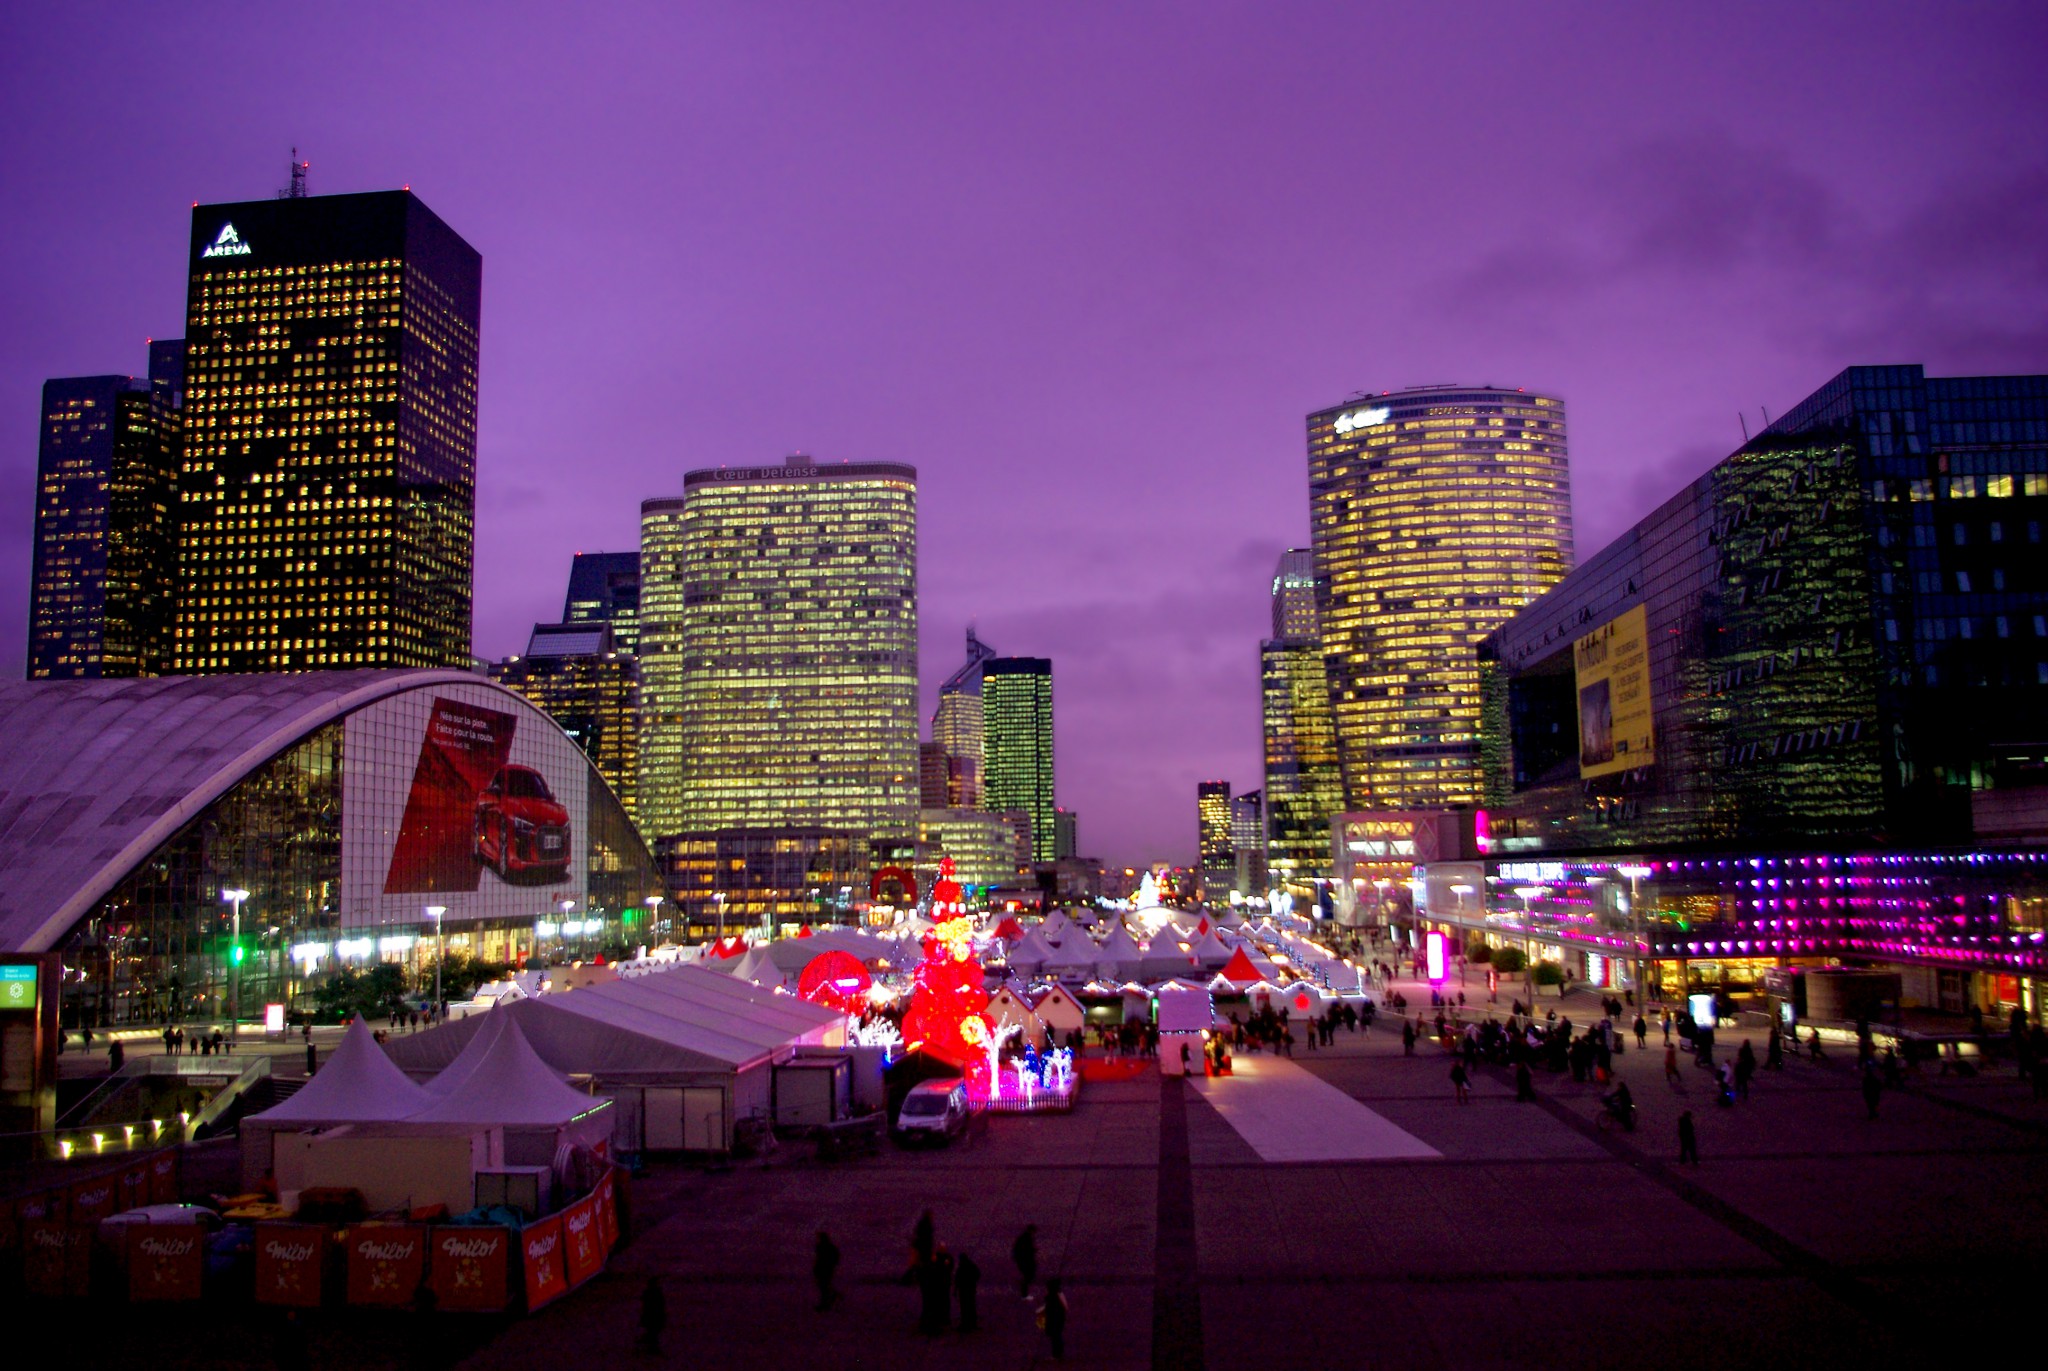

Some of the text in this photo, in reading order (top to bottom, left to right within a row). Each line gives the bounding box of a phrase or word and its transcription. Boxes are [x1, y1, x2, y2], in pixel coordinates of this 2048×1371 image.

[203, 244, 252, 257] AREVA
[453, 714, 464, 724] sur
[464, 715, 471, 726] la
[435, 722, 453, 735] Faite
[453, 727, 469, 738] pour
[469, 729, 477, 740] la
[1499, 863, 1512, 879] LES
[1538, 862, 1564, 880] TEMPS
